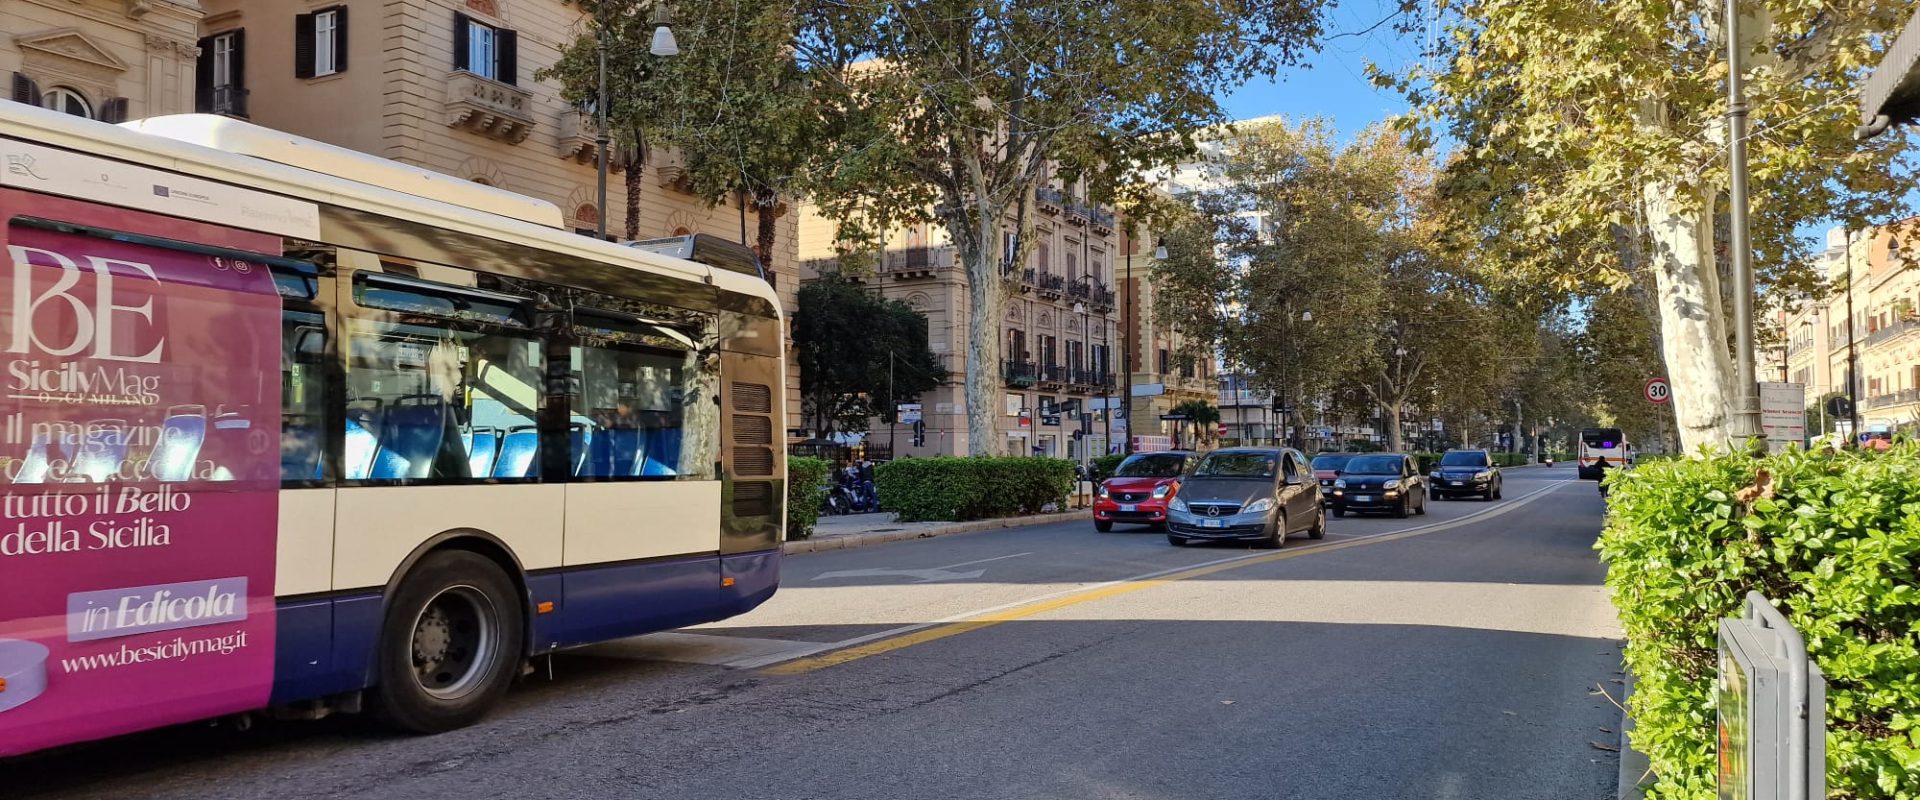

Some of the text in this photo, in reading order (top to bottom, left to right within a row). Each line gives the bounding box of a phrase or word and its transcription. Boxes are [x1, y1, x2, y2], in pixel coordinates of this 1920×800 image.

[5, 244, 165, 364] BE
[7, 359, 161, 405] SicilyMag
[1650, 385, 1667, 397] 30
[7, 412, 183, 453] Il magazine
[4, 455, 69, 481] ce
[3, 482, 191, 519] tutto il Bello
[0, 517, 171, 556] della Sicilia
[81, 584, 236, 633] in Edicola
[61, 629, 248, 674] www.besicilymag.it
